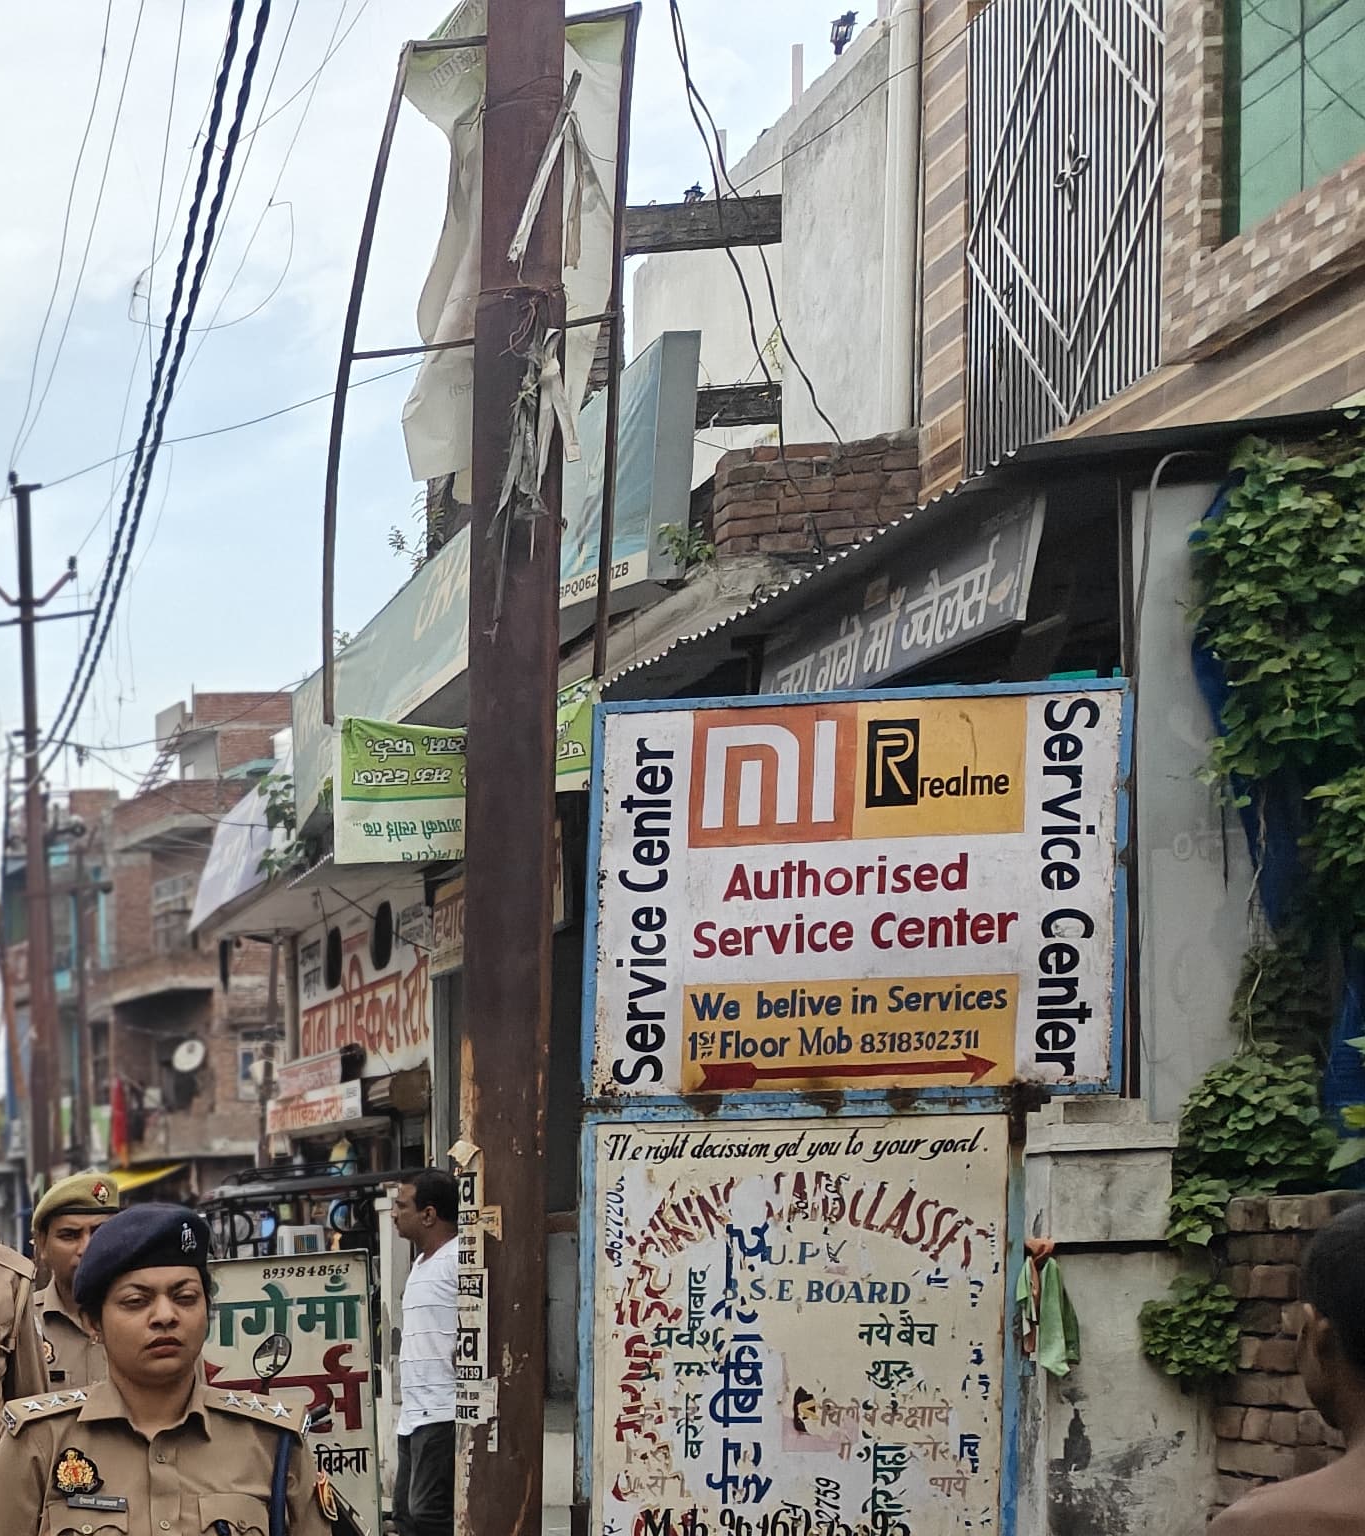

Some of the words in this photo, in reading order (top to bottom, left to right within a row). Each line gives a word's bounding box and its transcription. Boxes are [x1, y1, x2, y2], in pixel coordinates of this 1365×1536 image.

[919, 766, 1010, 799] realme
[1040, 698, 1101, 891] Service
[618, 736, 674, 893] Center
[722, 852, 969, 901] Authorised
[693, 914, 854, 959] Service
[871, 908, 1019, 949] Center
[613, 906, 668, 1086] Service
[690, 992, 741, 1021] We
[757, 988, 842, 1019] belive
[851, 985, 877, 1014] in
[887, 983, 1008, 1013] Services
[1034, 908, 1095, 1076] Center
[719, 1030, 790, 1059] Floor
[797, 1026, 853, 1056] Mob
[860, 1030, 980, 1053] 8318302311
[645, 1132, 690, 1164] right
[690, 1134, 769, 1160] decission
[766, 1131, 808, 1164] get
[798, 1139, 840, 1164] you
[845, 1128, 865, 1156] to
[863, 1136, 928, 1162] your
[262, 1263, 351, 1281] 8939848563
[806, 1280, 912, 1306] BOARD
